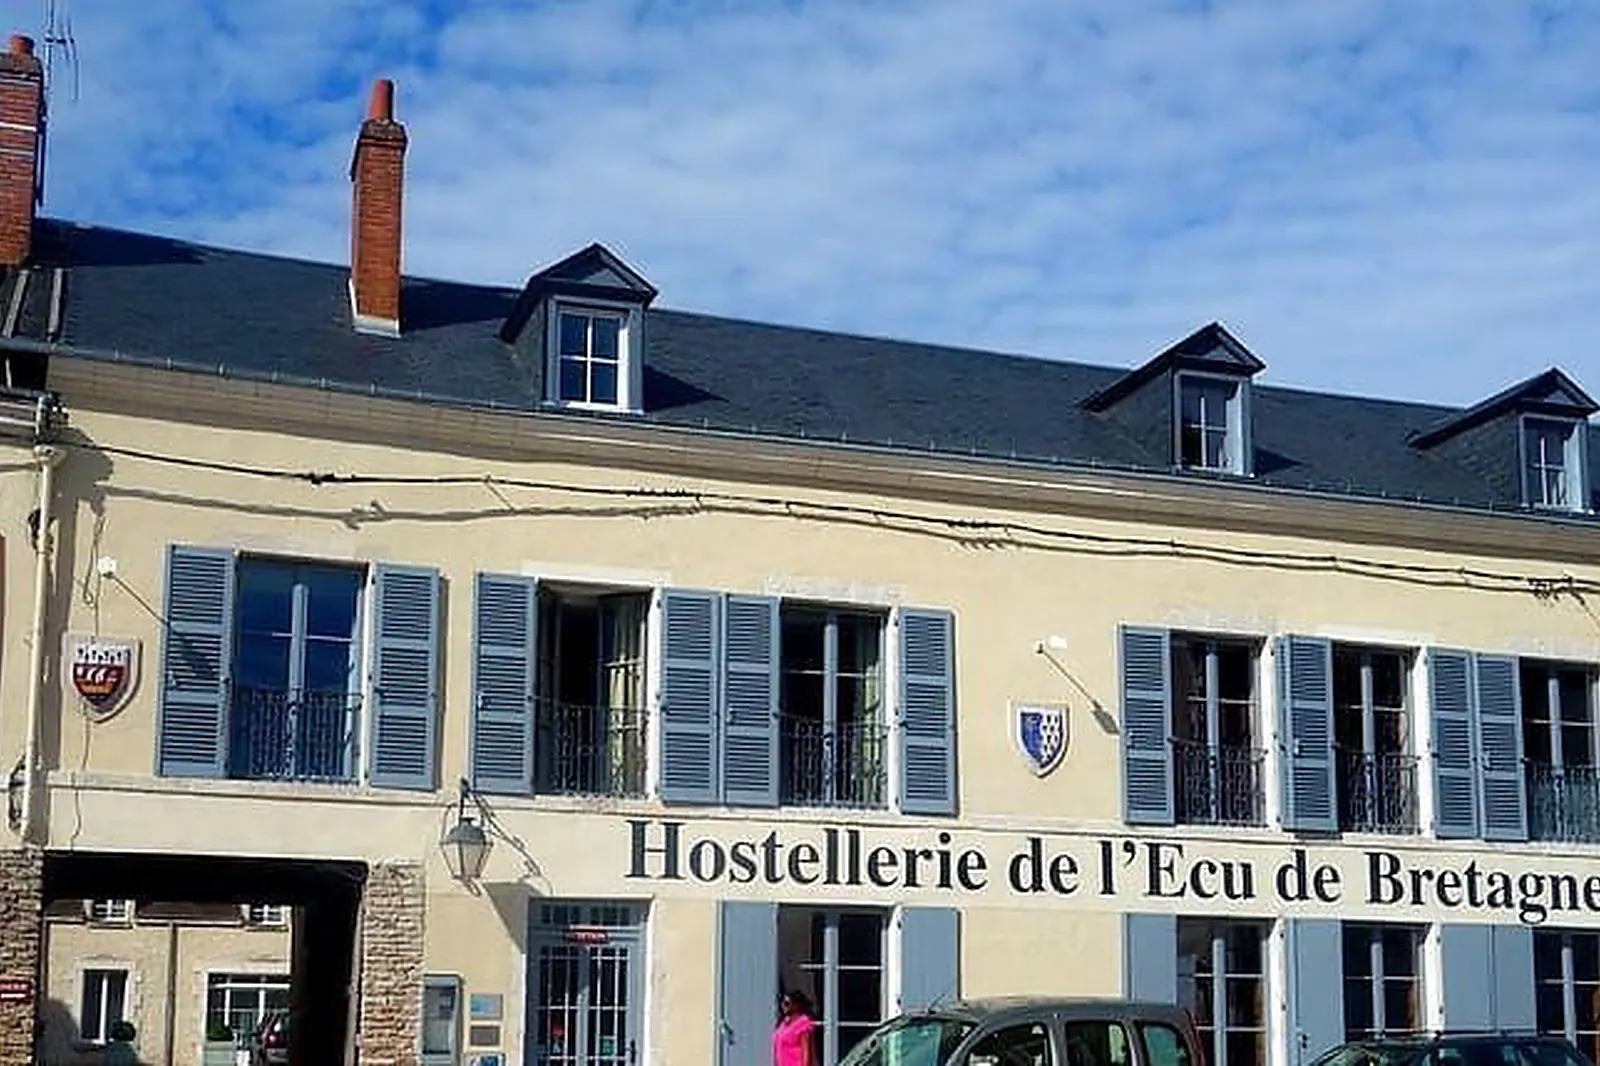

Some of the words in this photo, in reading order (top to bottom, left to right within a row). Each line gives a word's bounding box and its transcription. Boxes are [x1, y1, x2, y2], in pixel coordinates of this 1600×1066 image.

[624, 819, 988, 891] Hostellerie
[1009, 837, 1078, 895] de
[1099, 840, 1256, 899] l’Ecu
[1276, 849, 1341, 902] de
[1364, 851, 1600, 926] Bretagne
